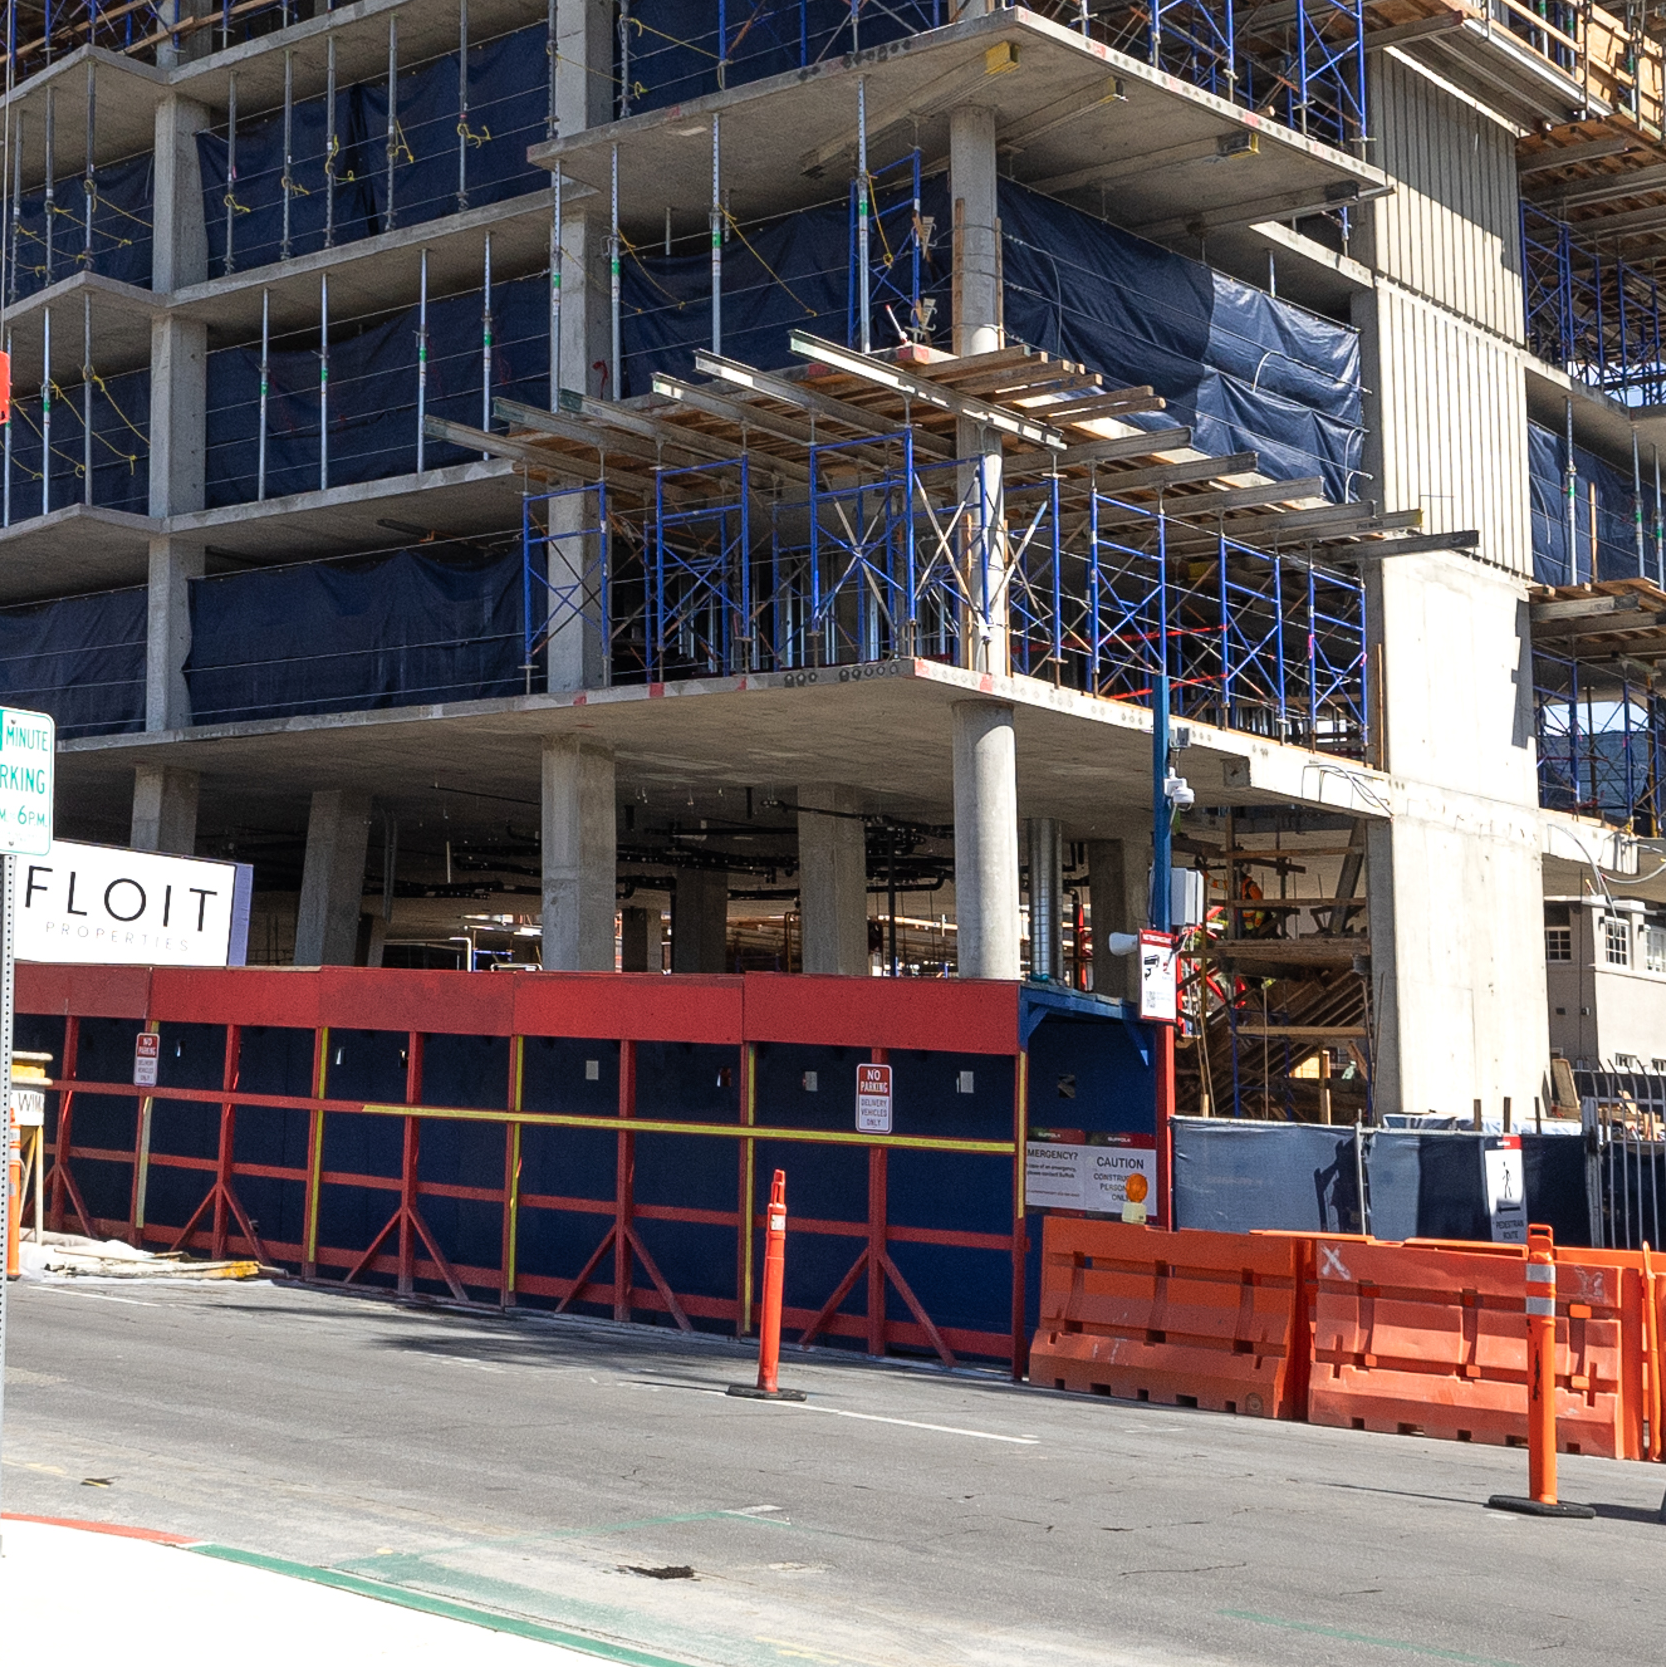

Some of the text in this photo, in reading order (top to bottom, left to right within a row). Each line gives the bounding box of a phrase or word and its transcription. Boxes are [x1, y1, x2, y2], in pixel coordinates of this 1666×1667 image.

[6, 726, 48, 751] MINUTE
[25, 865, 218, 932] FLOIT
[45, 921, 189, 952] PROPERTIES
[867, 1069, 881, 1081] NO
[860, 1081, 888, 1093] PARKING
[861, 1098, 887, 1107] DELIVERY
[861, 1108, 887, 1117] VEHICLES
[866, 1118, 881, 1126] ONLY
[1027, 1149, 1079, 1161] MERGENCY?
[1096, 1156, 1144, 1169] CAUTION
[1093, 1173, 1130, 1182] CONSTRU
[1111, 1194, 1129, 1202] ONL
